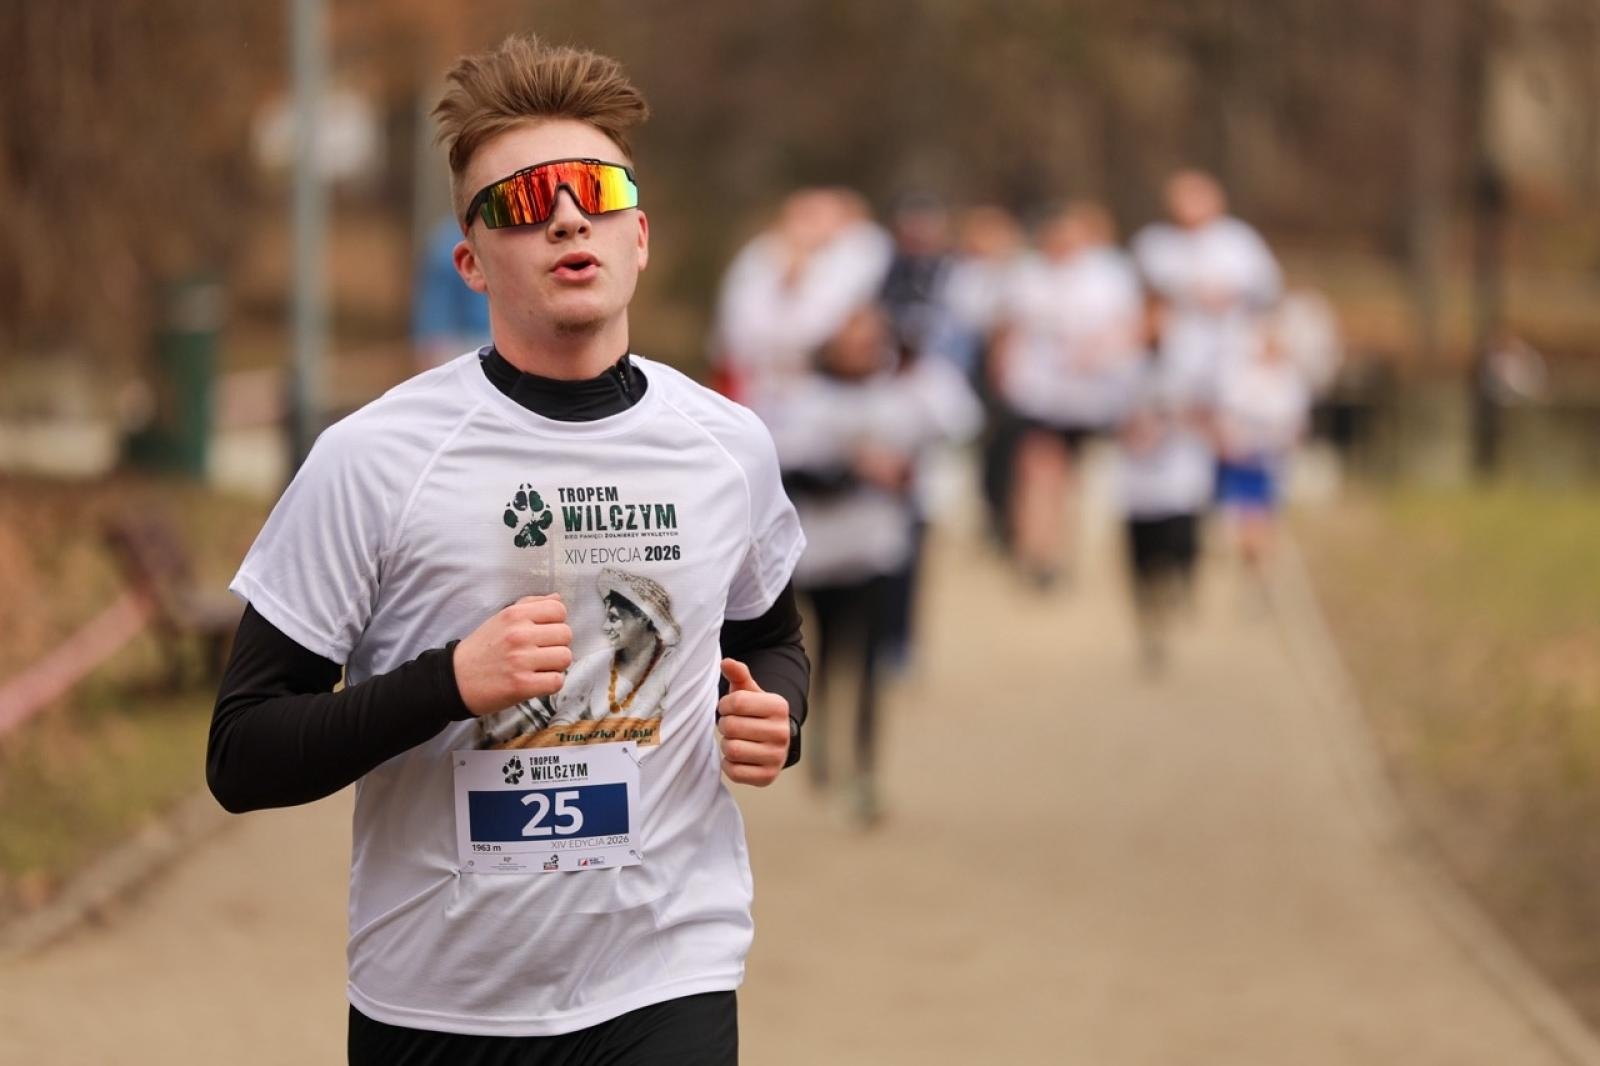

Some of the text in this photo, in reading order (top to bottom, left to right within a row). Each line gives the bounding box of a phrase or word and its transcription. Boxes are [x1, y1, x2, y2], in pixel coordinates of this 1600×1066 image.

[558, 487, 619, 503] TROPEM
[561, 503, 678, 532] WILCZYM
[564, 545, 681, 565] XIV EDYCJA 2026
[530, 755, 560, 766] TROPEM
[530, 763, 588, 780] WILCZYM
[520, 790, 584, 837] 25
[472, 843, 491, 852] 1963
[551, 834, 629, 849] XIV EDYCJA 2026
